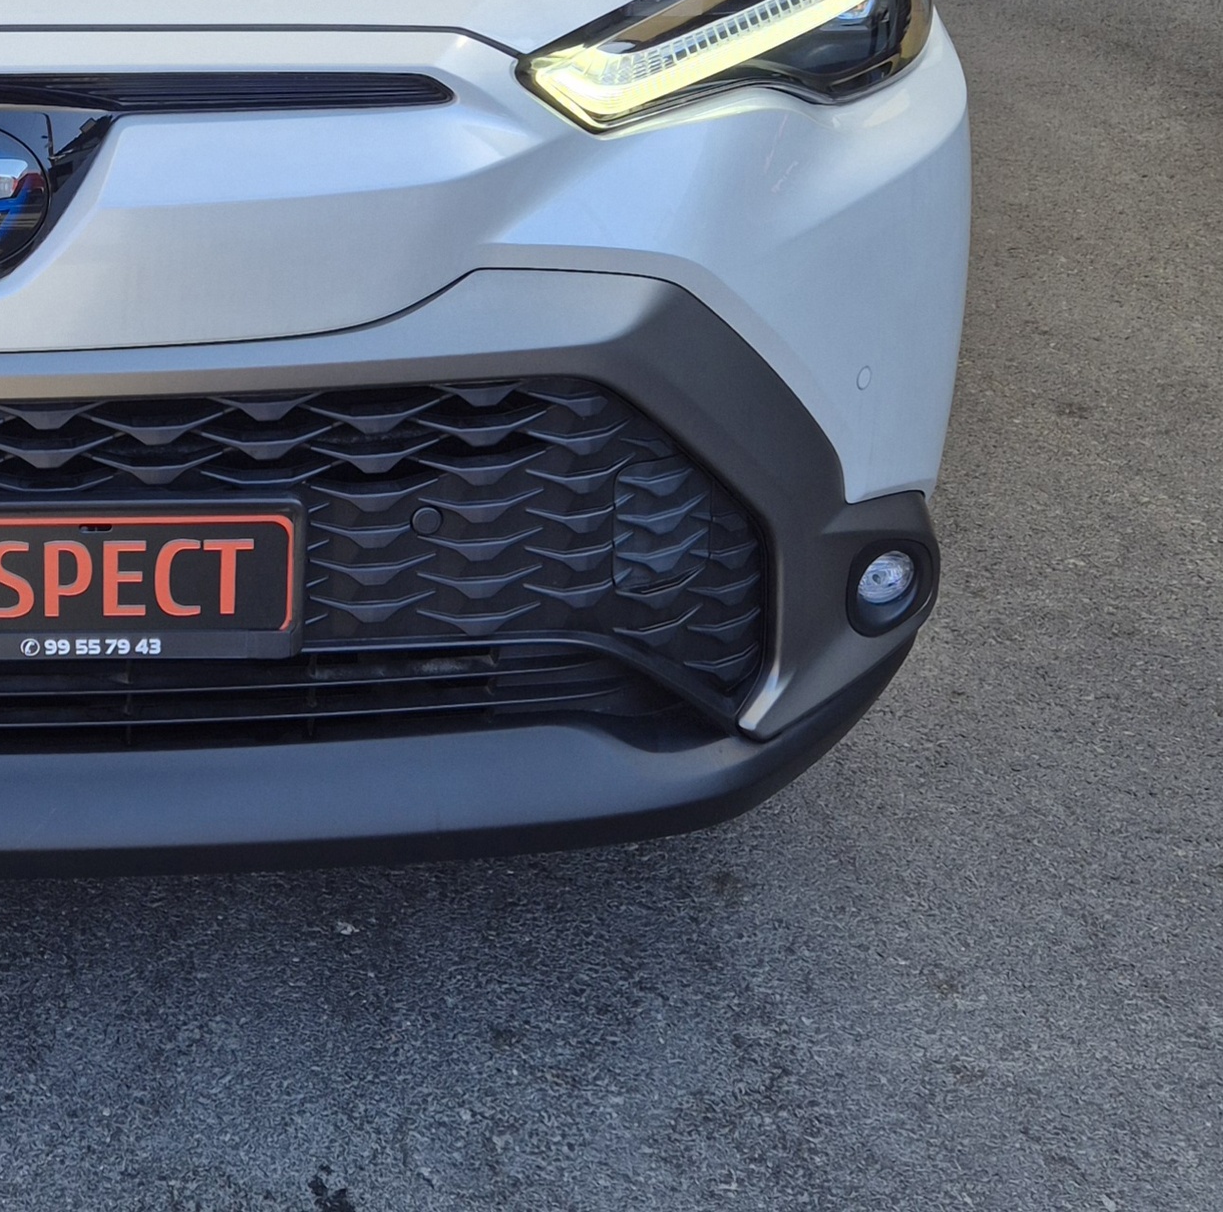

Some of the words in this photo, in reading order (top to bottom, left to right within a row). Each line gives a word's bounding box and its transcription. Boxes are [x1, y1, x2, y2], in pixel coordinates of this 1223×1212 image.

[44, 639, 71, 655] 99
[75, 639, 101, 655] 55
[104, 639, 131, 655] 79
[134, 638, 162, 655] 43
